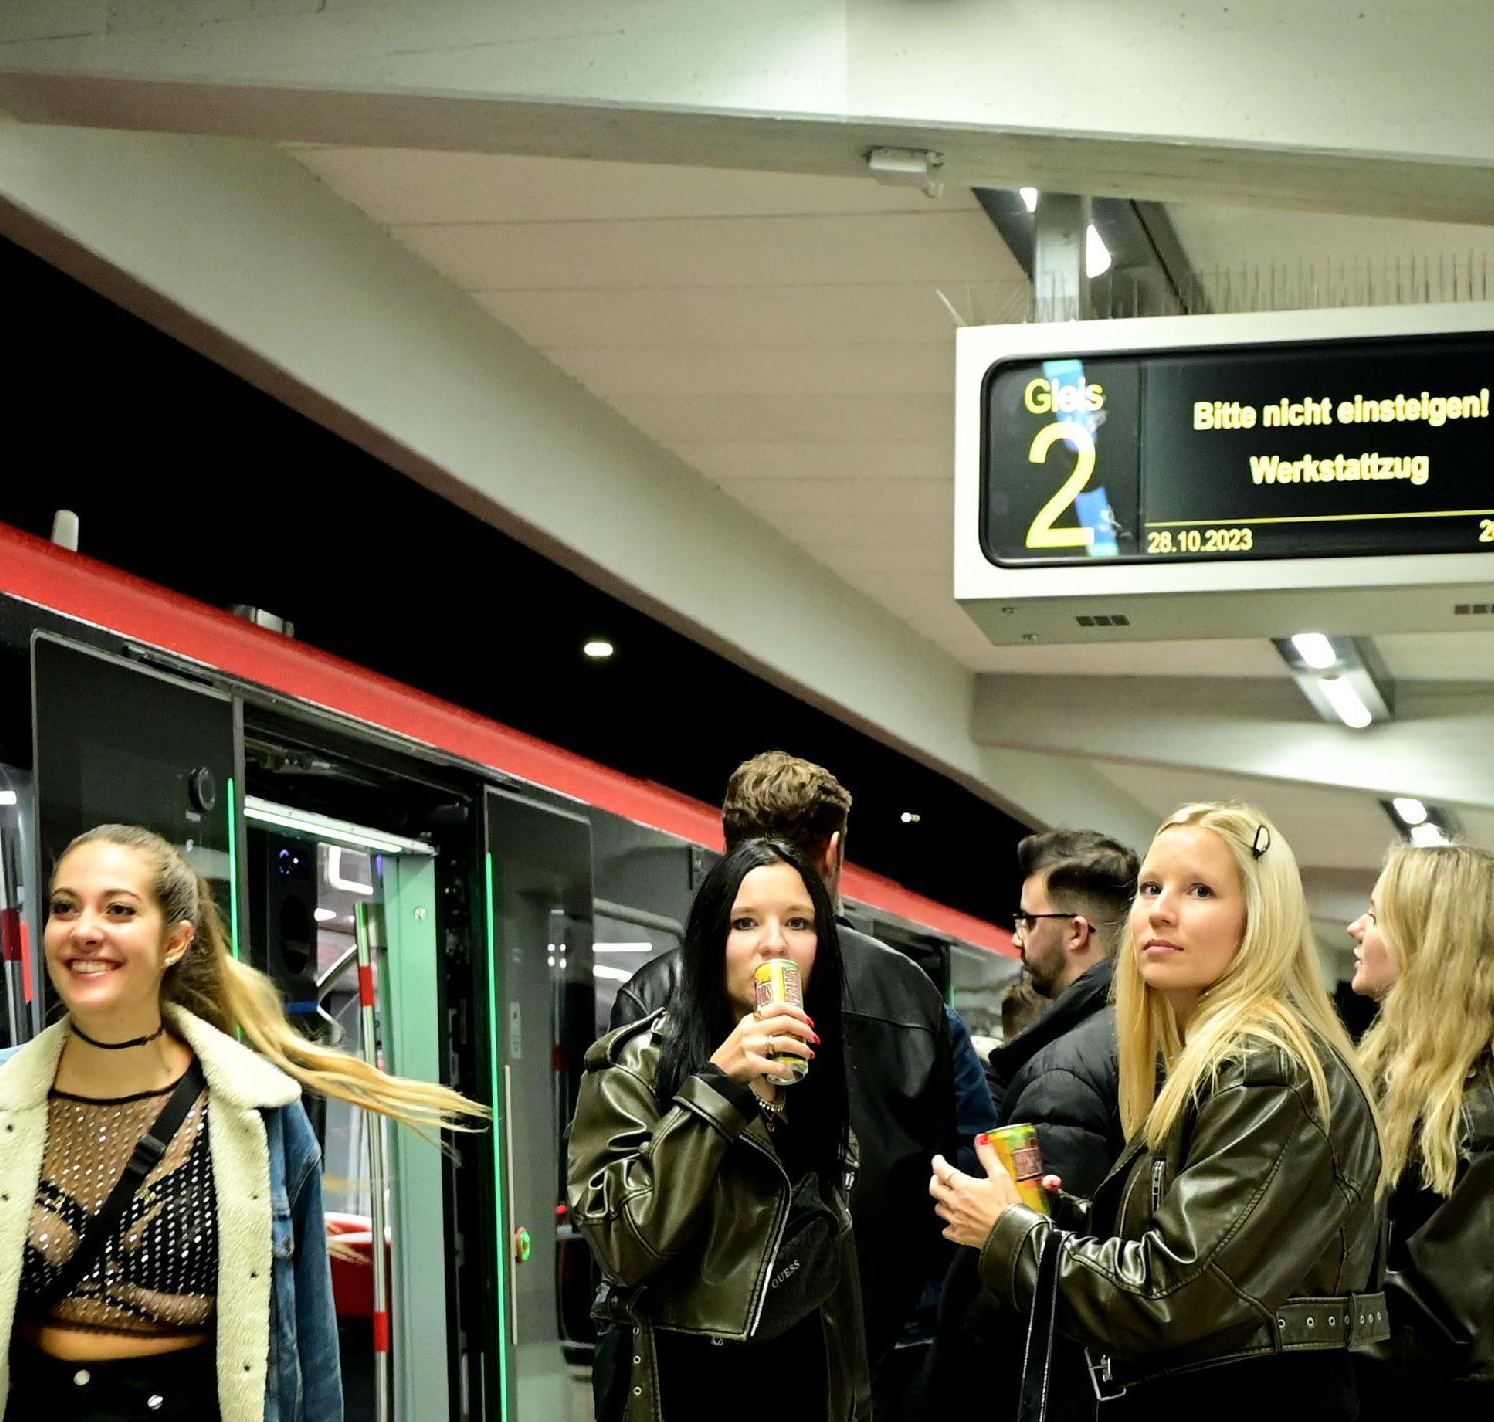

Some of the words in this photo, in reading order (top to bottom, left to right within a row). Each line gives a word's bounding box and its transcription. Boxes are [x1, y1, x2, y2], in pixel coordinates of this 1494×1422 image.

[1024, 377, 1105, 414] Gleis
[1193, 401, 1257, 430] Bitte
[1262, 396, 1332, 427] nicht
[1336, 388, 1490, 427] einsteigen!
[1025, 421, 1096, 549] 2
[1249, 452, 1430, 486] Werkstattzug
[1147, 528, 1253, 554] 28.10.2023
